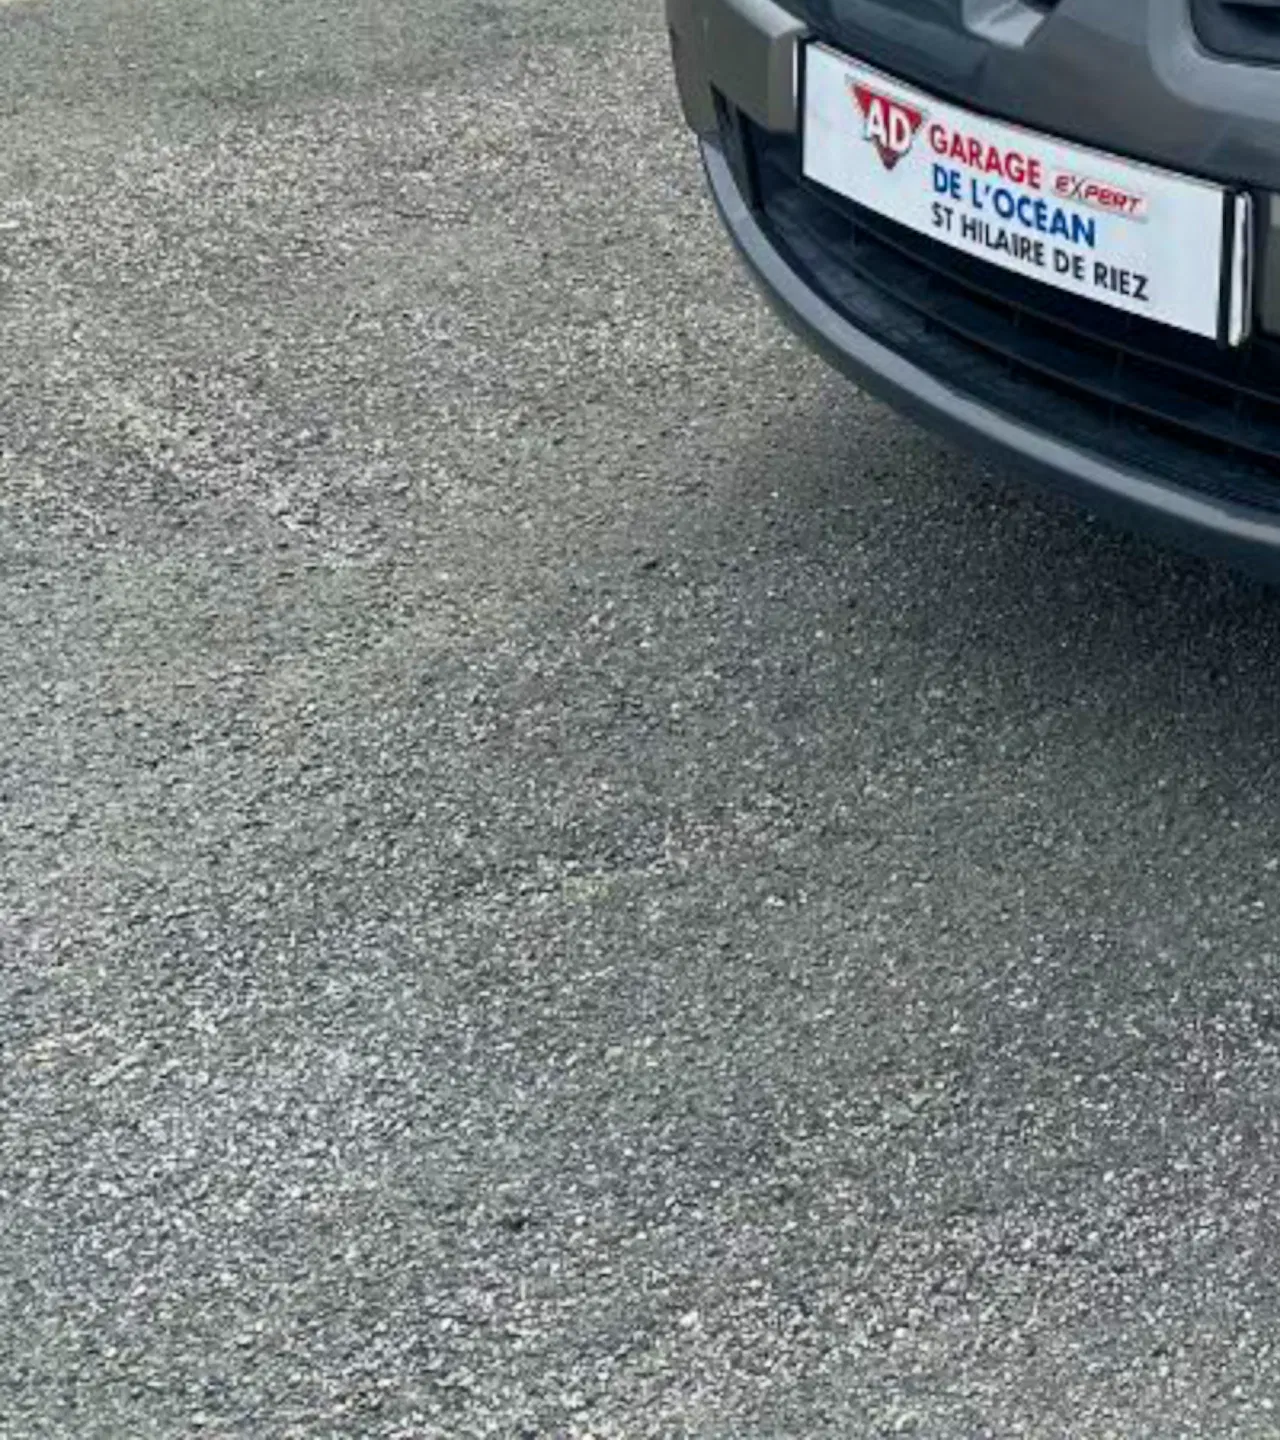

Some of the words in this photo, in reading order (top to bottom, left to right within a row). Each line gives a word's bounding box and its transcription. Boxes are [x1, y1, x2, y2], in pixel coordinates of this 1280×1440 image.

[868, 97, 912, 152] AD
[929, 123, 1041, 190] GARAGE
[932, 162, 962, 201] DE
[930, 200, 955, 232] ST
[960, 213, 1046, 267] HILAIRE
[1053, 247, 1085, 281] DE
[1093, 261, 1150, 302] RIEZ
